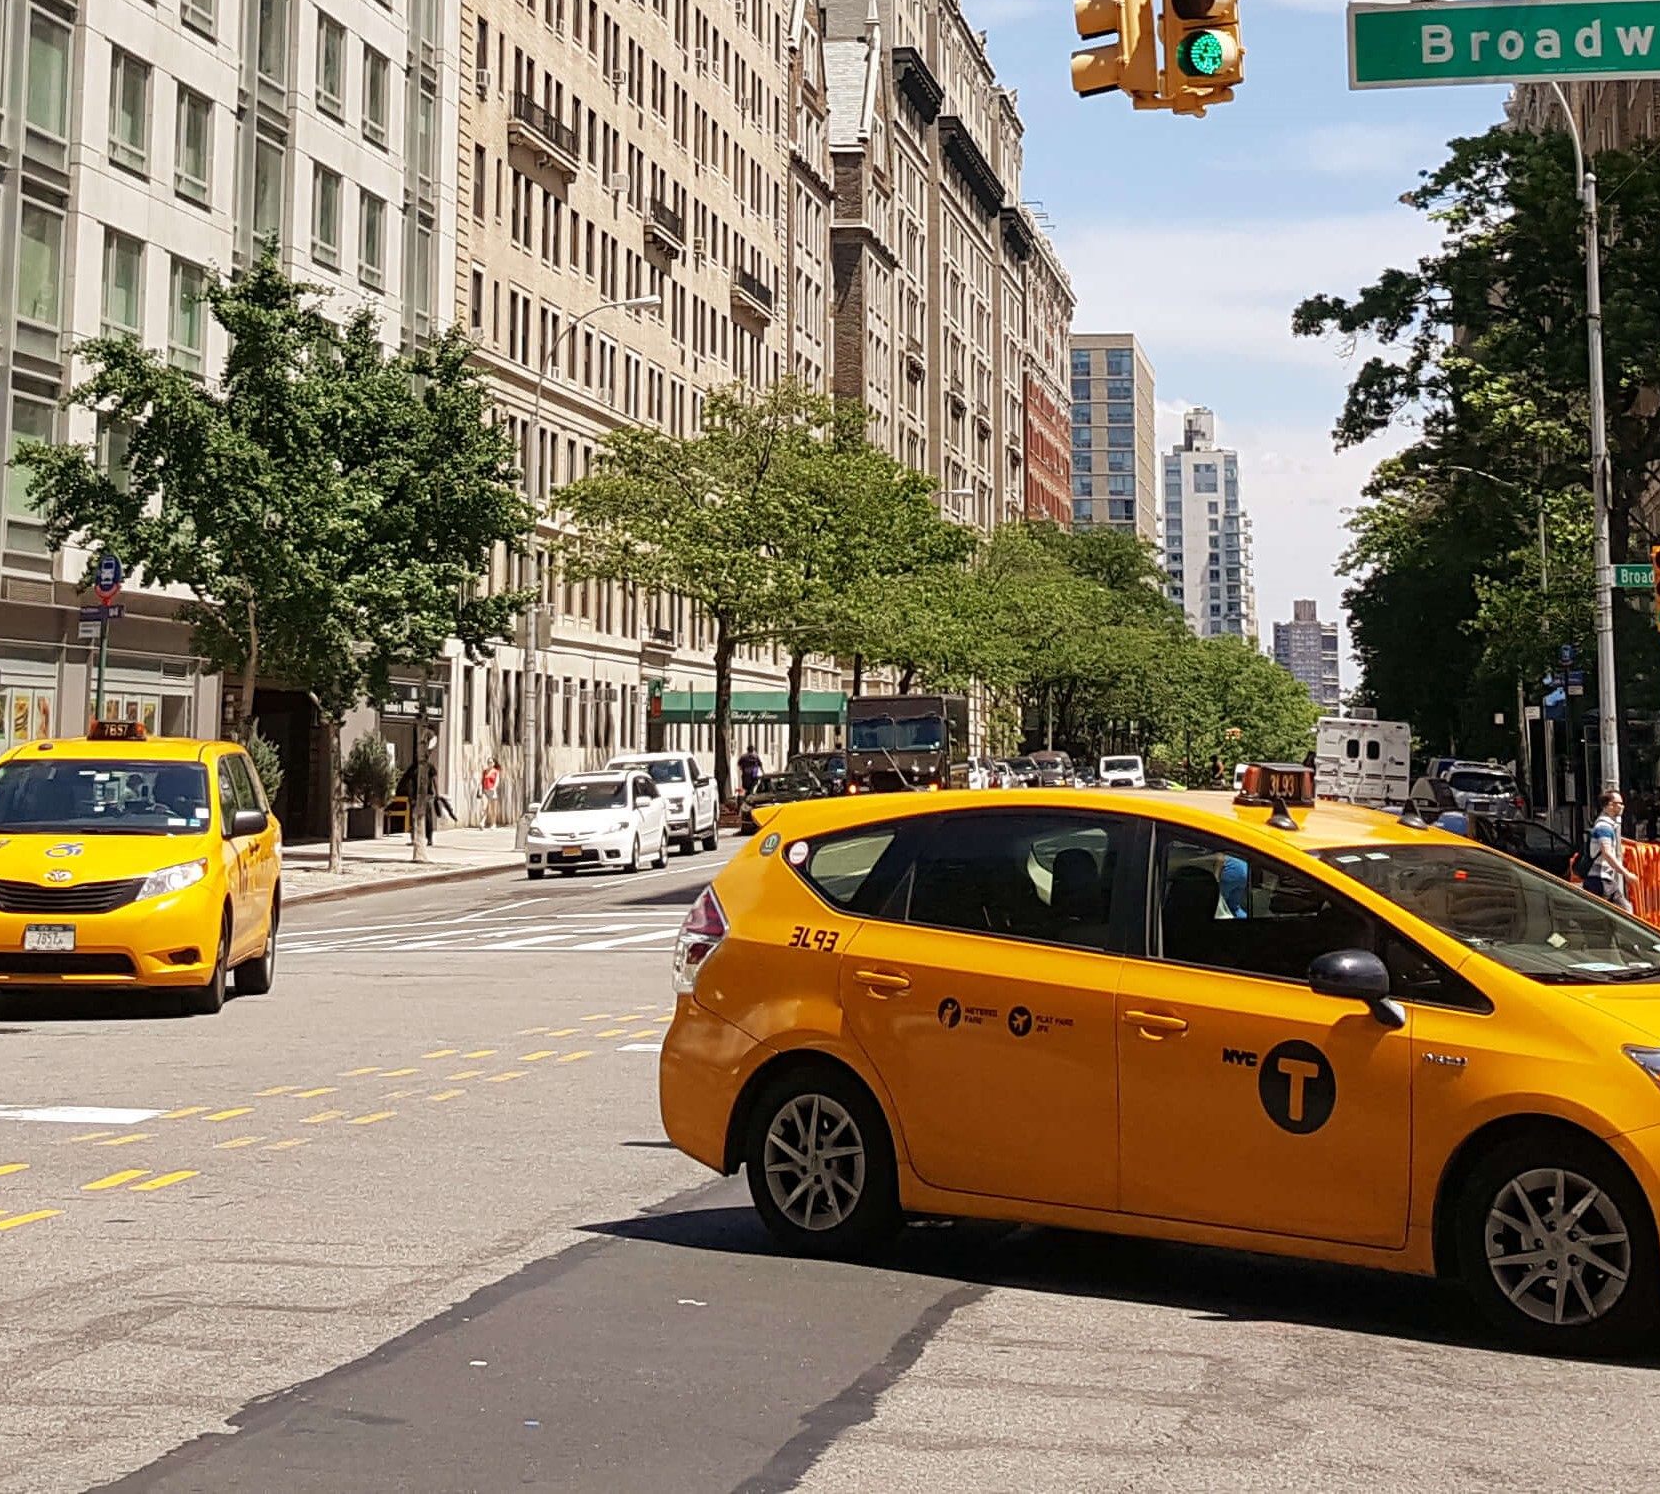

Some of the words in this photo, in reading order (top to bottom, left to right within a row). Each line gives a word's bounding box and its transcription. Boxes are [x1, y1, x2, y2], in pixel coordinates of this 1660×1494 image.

[1620, 568, 1655, 584] Broad
[1269, 773, 1295, 798] 3L93
[788, 925, 840, 953] 3L93
[1222, 1047, 1259, 1067] NYC
[1277, 1057, 1319, 1122] T
